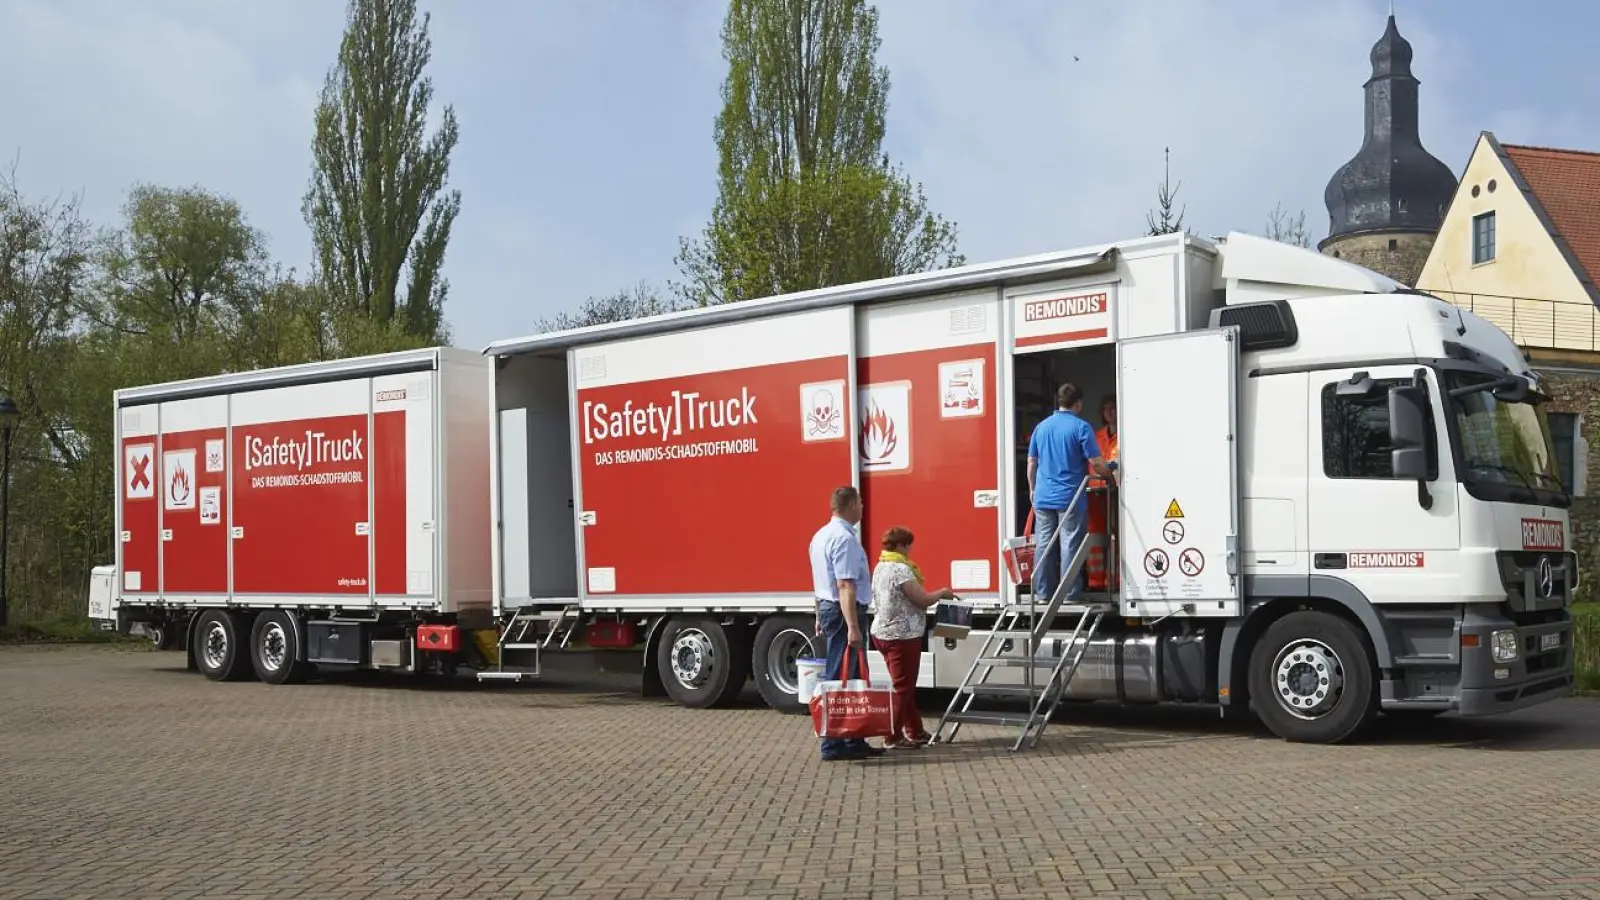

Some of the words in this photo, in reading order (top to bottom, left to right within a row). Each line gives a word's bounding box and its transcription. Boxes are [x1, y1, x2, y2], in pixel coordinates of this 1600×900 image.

[595, 452, 613, 466] DAS
[615, 438, 758, 464] REMONDIS-SCHADSTOFFMOBIL
[252, 477, 265, 488] DAS
[266, 471, 363, 487] REMONDIS-SCHADSTOFFMOBIL
[836, 696, 850, 704] den
